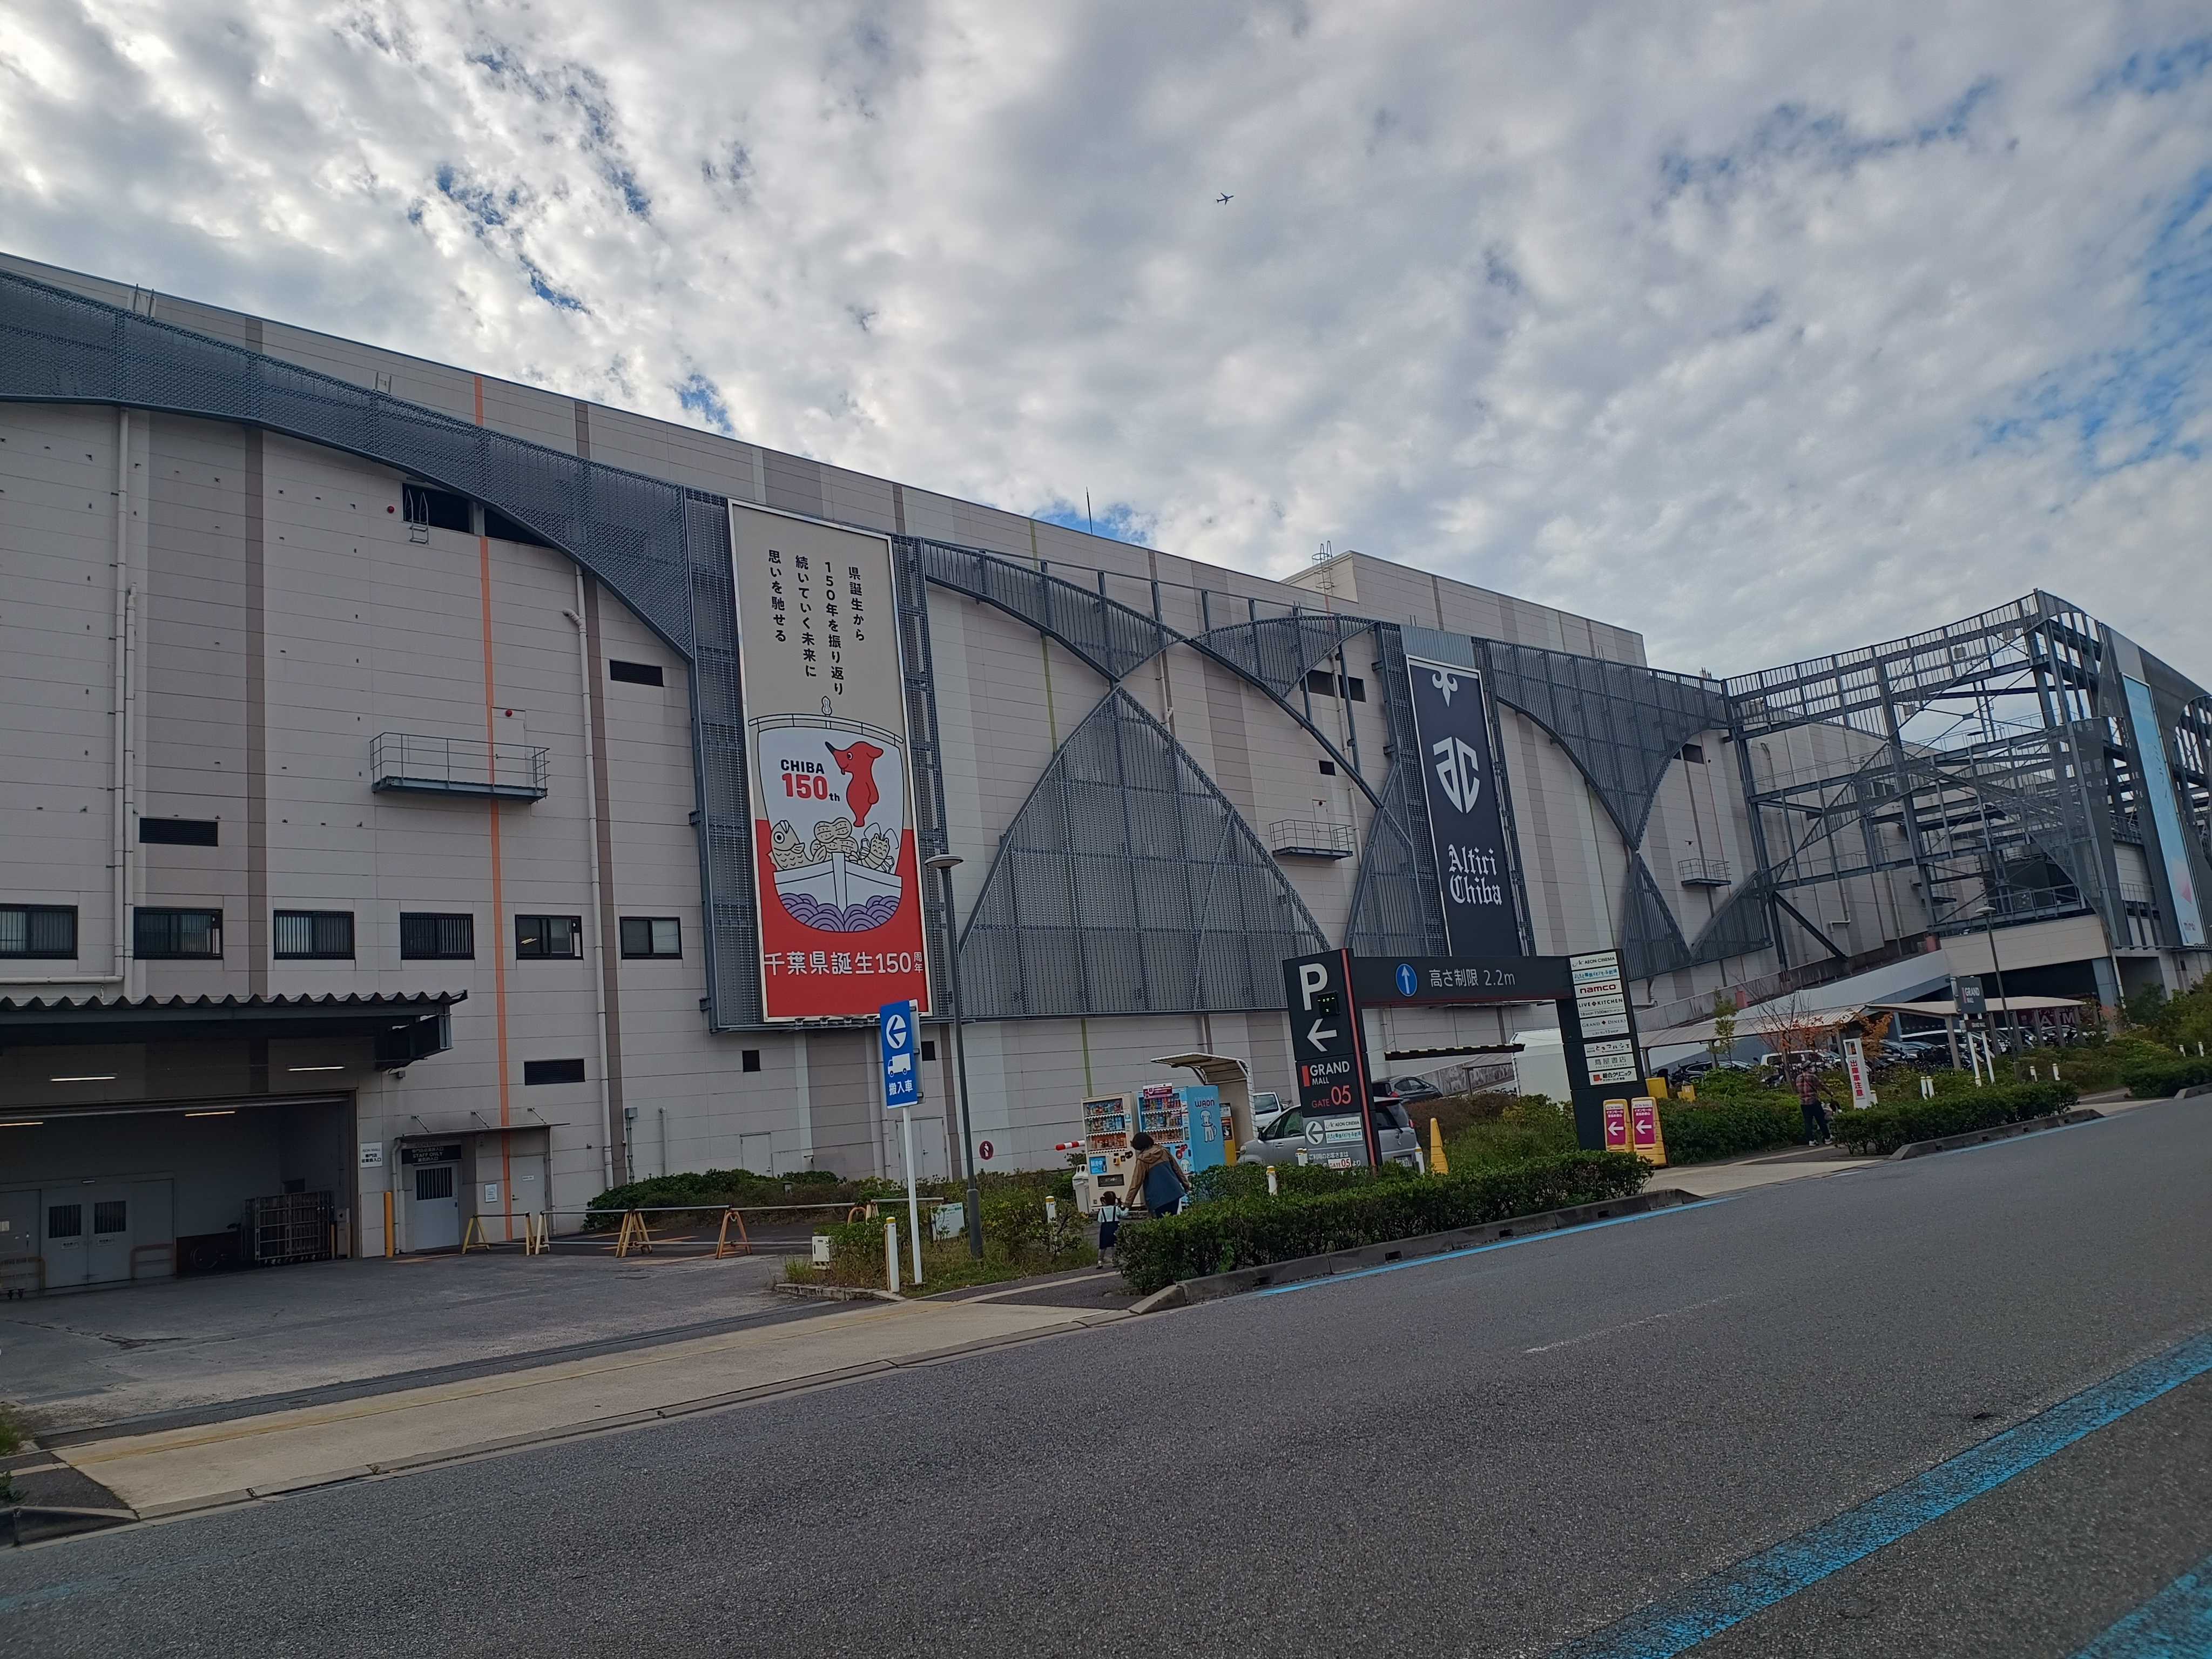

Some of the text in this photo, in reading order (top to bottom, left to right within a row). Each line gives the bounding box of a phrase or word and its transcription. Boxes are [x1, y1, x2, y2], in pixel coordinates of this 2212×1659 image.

[768, 549, 787, 642] 思いを馳せる
[848, 566, 865, 642] 県誕生から
[795, 555, 817, 678] 続いていく未来に
[825, 562, 844, 696] 150年を振り返り
[780, 759, 825, 774] CHIBA
[1449, 875, 1502, 906] Chiba
[1299, 963, 1328, 1011] P
[1429, 968, 1515, 988] 高さ制限 2.2m
[1580, 984, 1616, 994] namco
[1965, 987, 1980, 996] GRAND
[1310, 1061, 1350, 1077] GRAND
[888, 1079, 913, 1096] 搬入車
[1312, 1077, 1330, 1085] MALL
[1312, 1085, 1351, 1108] GATE 05
[1341, 1159, 1350, 1167] 05
